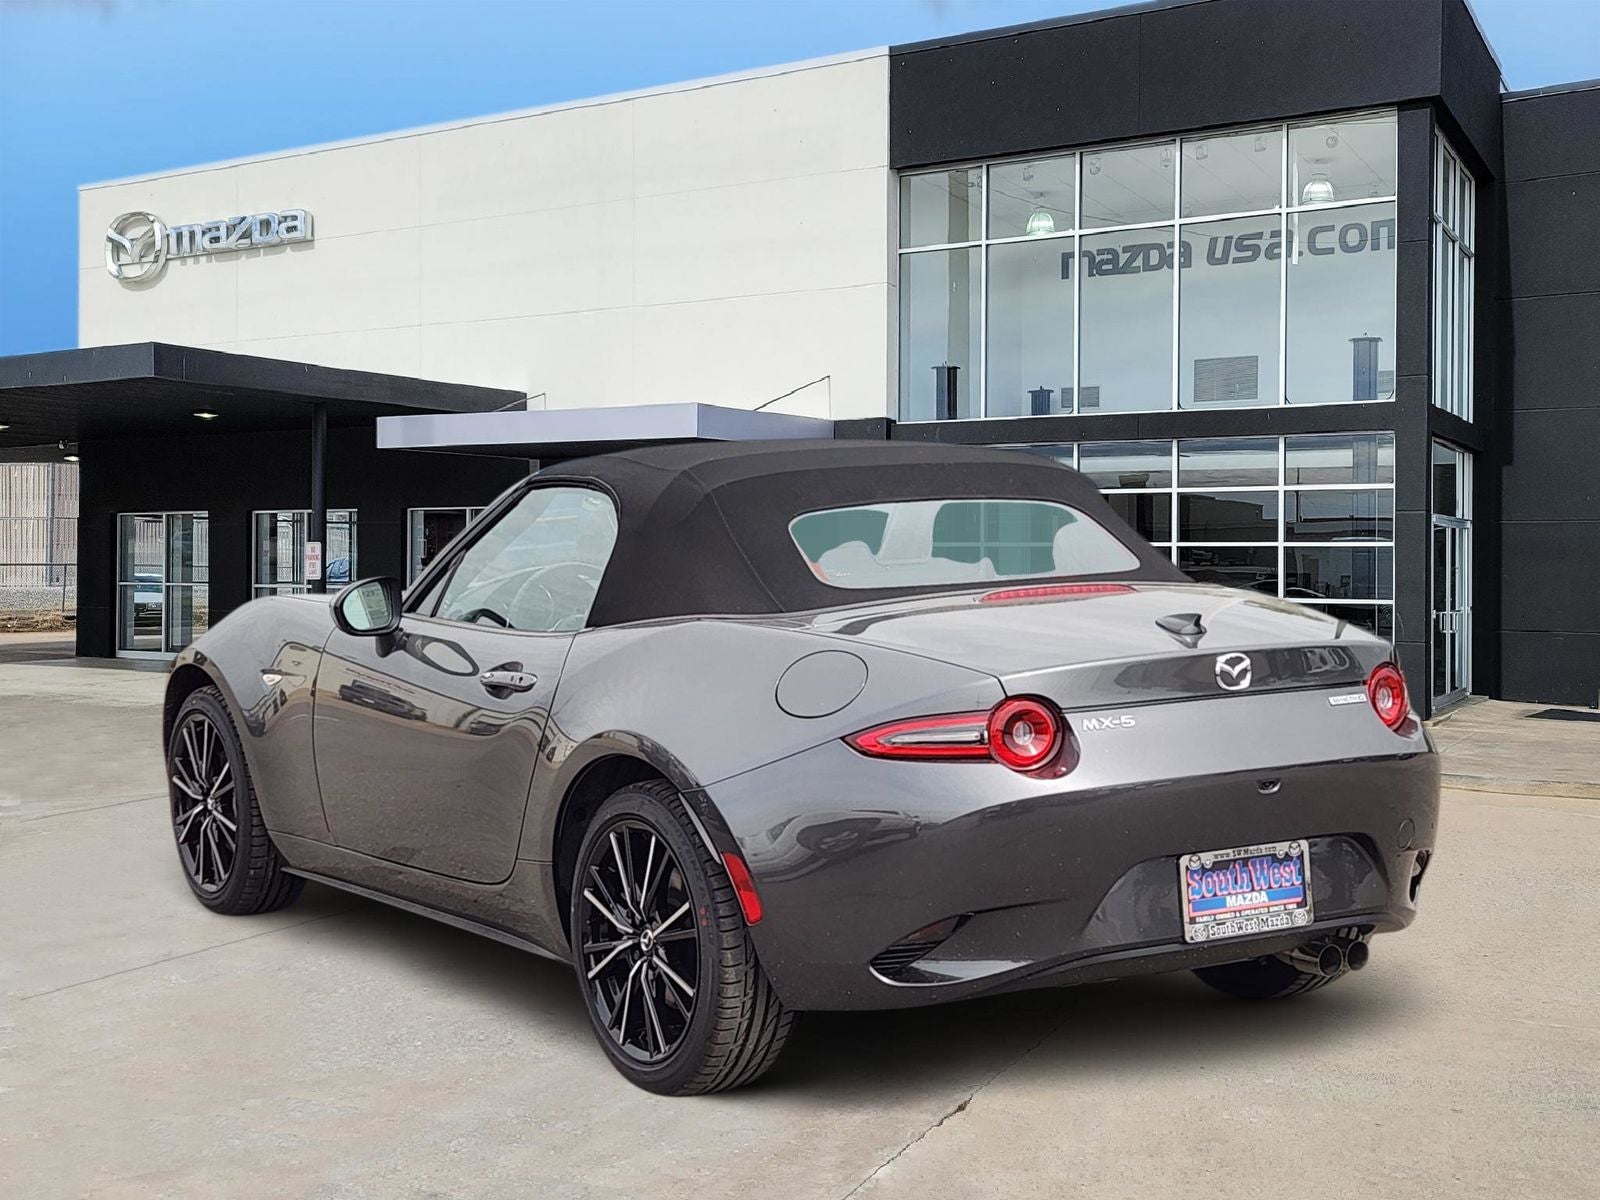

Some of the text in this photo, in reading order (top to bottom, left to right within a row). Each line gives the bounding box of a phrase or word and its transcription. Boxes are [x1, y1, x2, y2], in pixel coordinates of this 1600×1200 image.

[166, 209, 313, 257] mazda
[1082, 715, 1136, 731] MX-5
[1188, 857, 1302, 900] SouthWest
[1225, 891, 1269, 908] MAZDA
[1209, 914, 1291, 937] SouthWest Mazda
